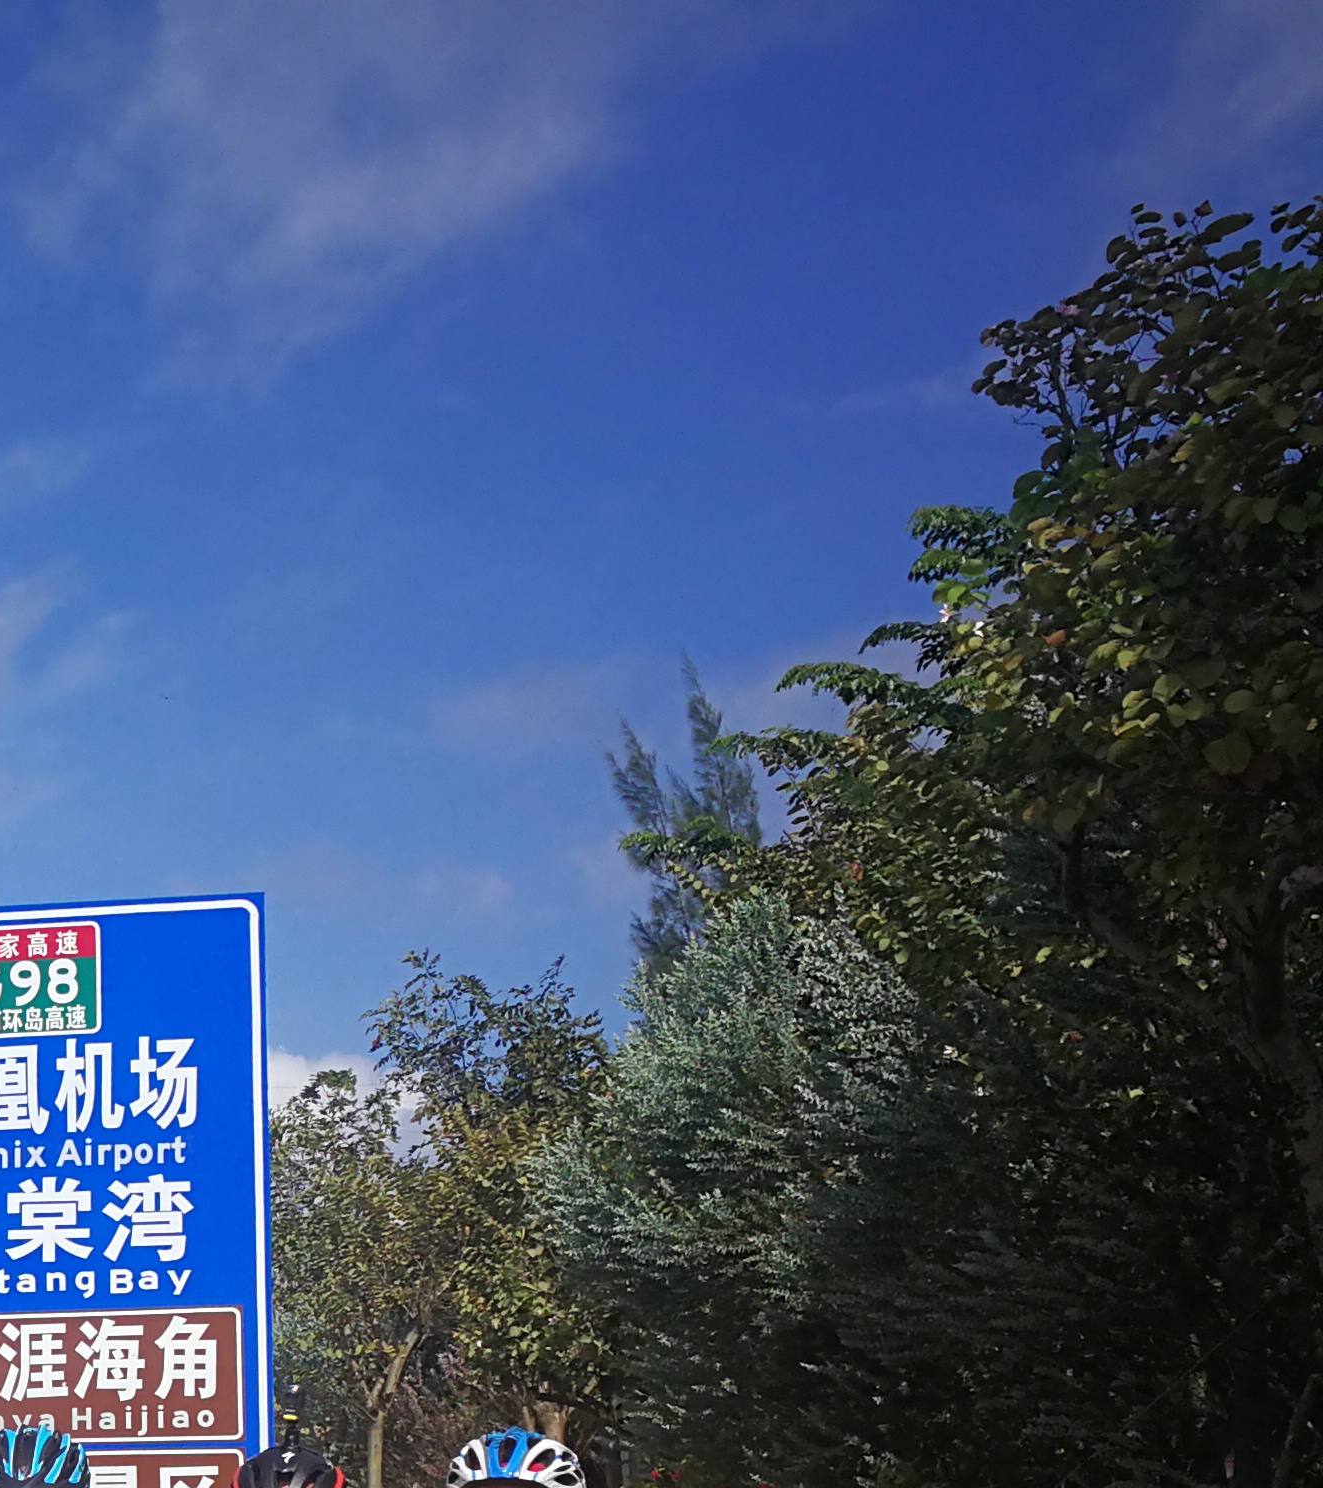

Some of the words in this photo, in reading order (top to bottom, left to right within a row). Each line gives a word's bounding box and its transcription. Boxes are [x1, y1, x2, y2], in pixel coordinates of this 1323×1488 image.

[57, 1135, 187, 1172] Airport
[110, 1269, 193, 1296] Bay
[71, 1405, 215, 1437] Haijiao
